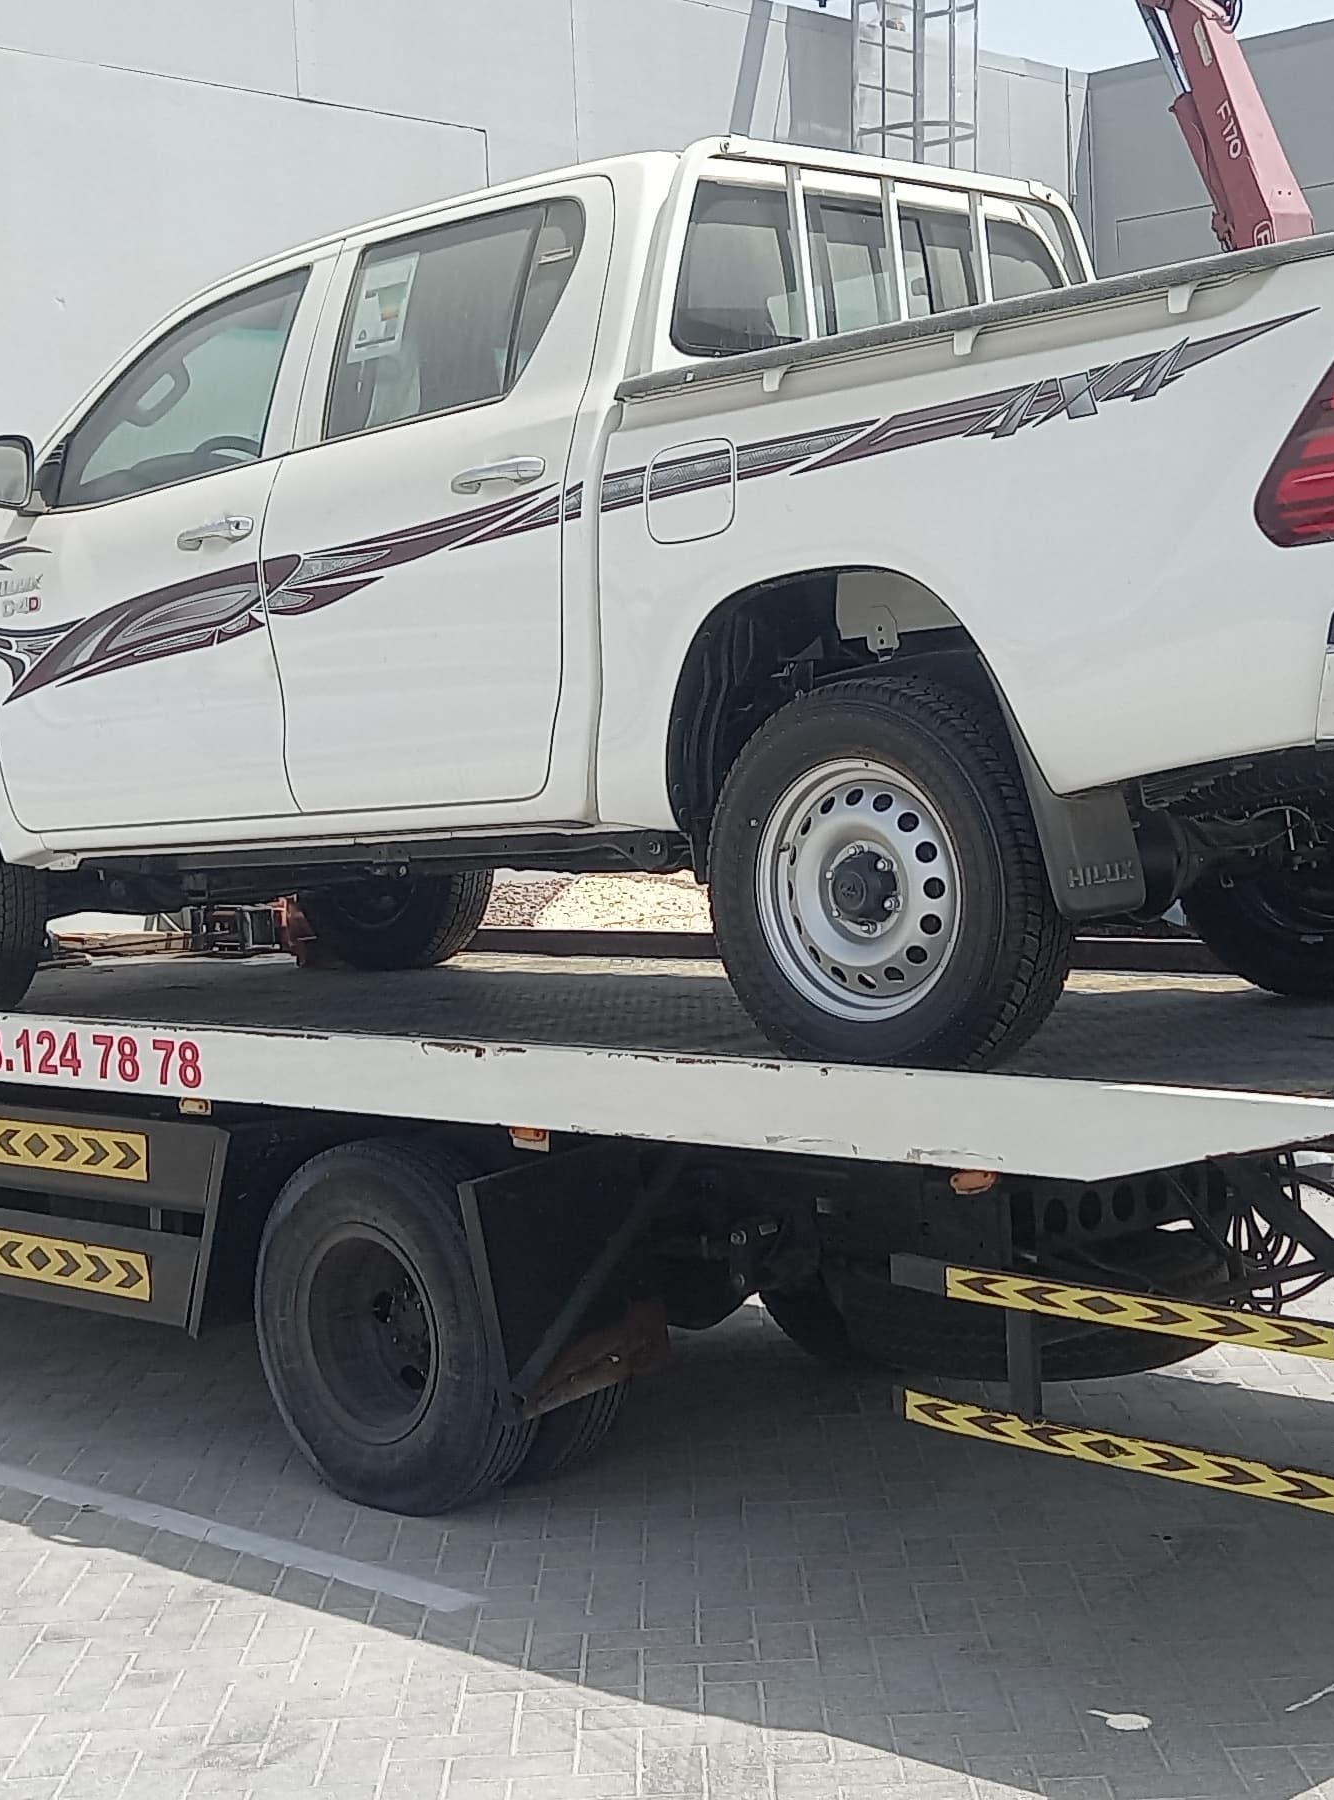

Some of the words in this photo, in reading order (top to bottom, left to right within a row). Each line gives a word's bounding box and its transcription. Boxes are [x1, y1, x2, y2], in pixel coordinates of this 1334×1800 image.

[963, 337, 1189, 440] 4X4
[1067, 860, 1135, 888] HILUX
[92, 1034, 140, 1082] 78
[152, 1038, 202, 1088] 78
